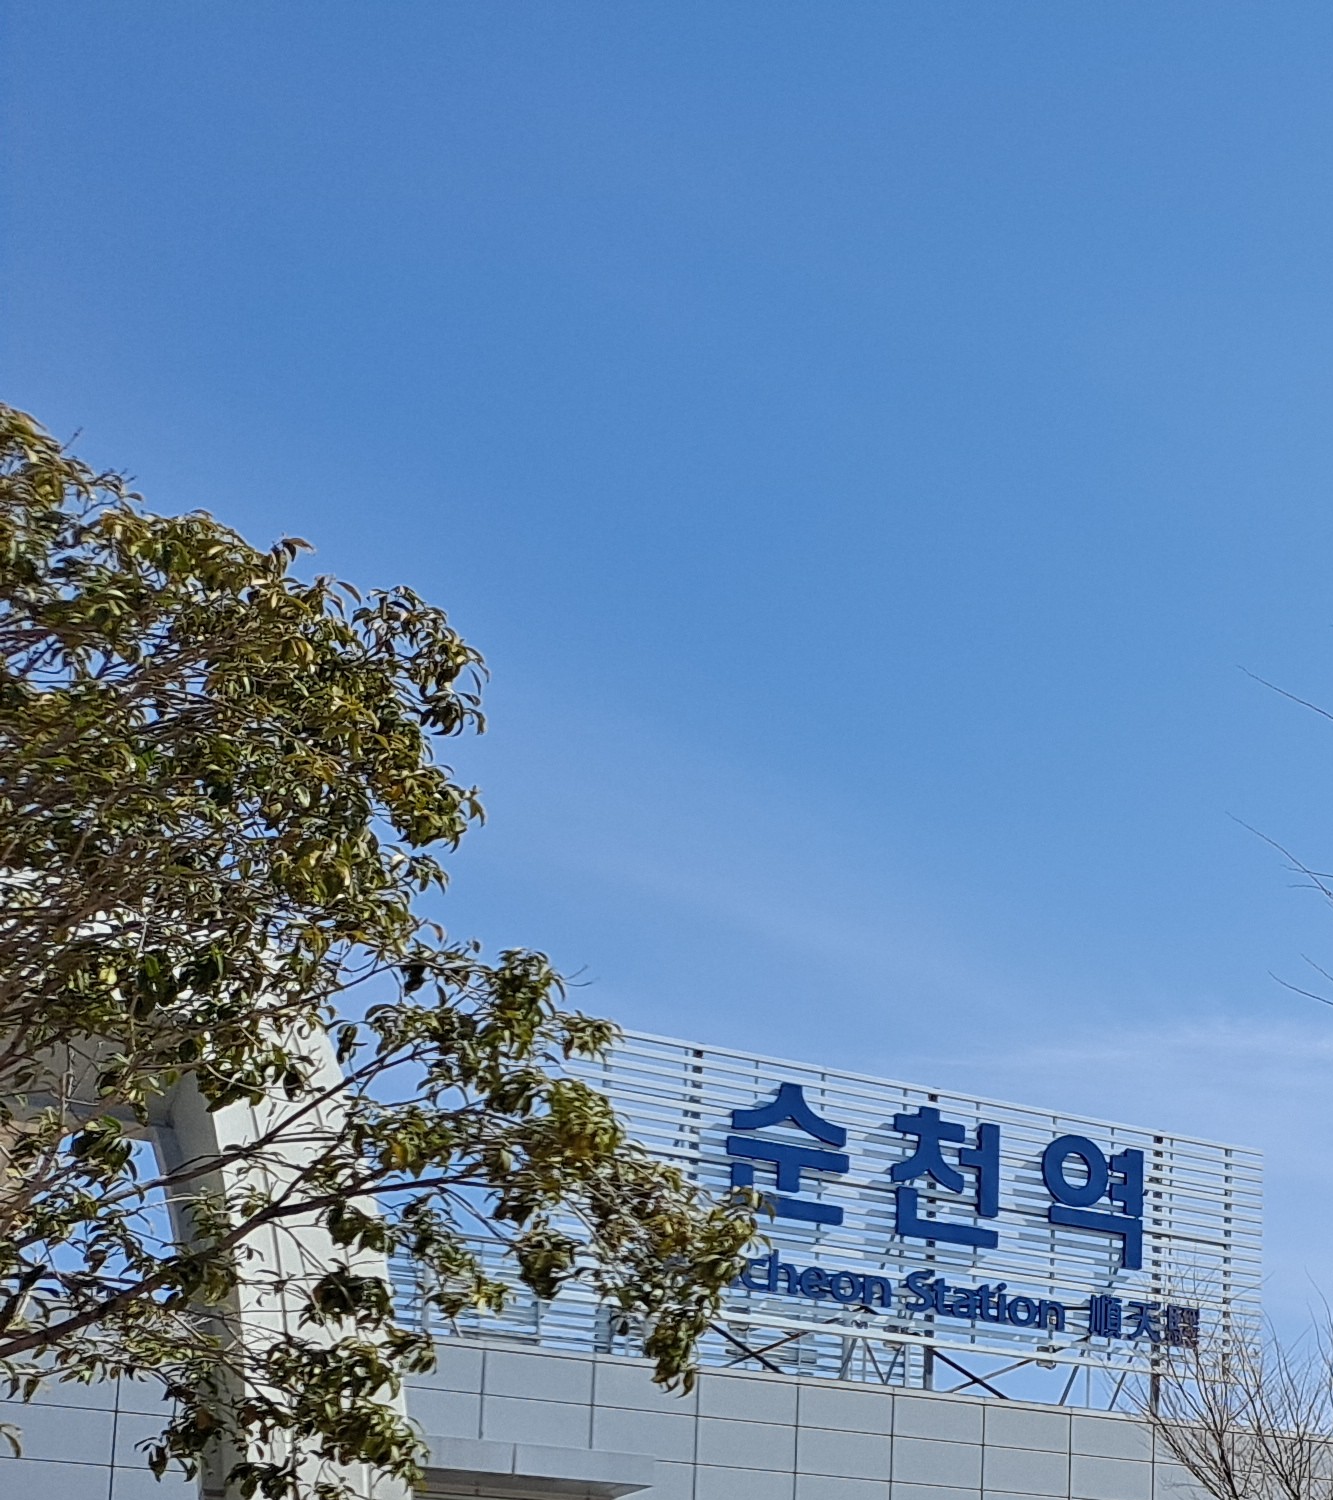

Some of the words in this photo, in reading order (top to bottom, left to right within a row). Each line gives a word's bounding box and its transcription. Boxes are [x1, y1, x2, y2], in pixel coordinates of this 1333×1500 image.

[726, 1082, 1145, 1271] 순천역
[730, 1248, 893, 1309] cheon
[904, 1269, 1066, 1333] Station
